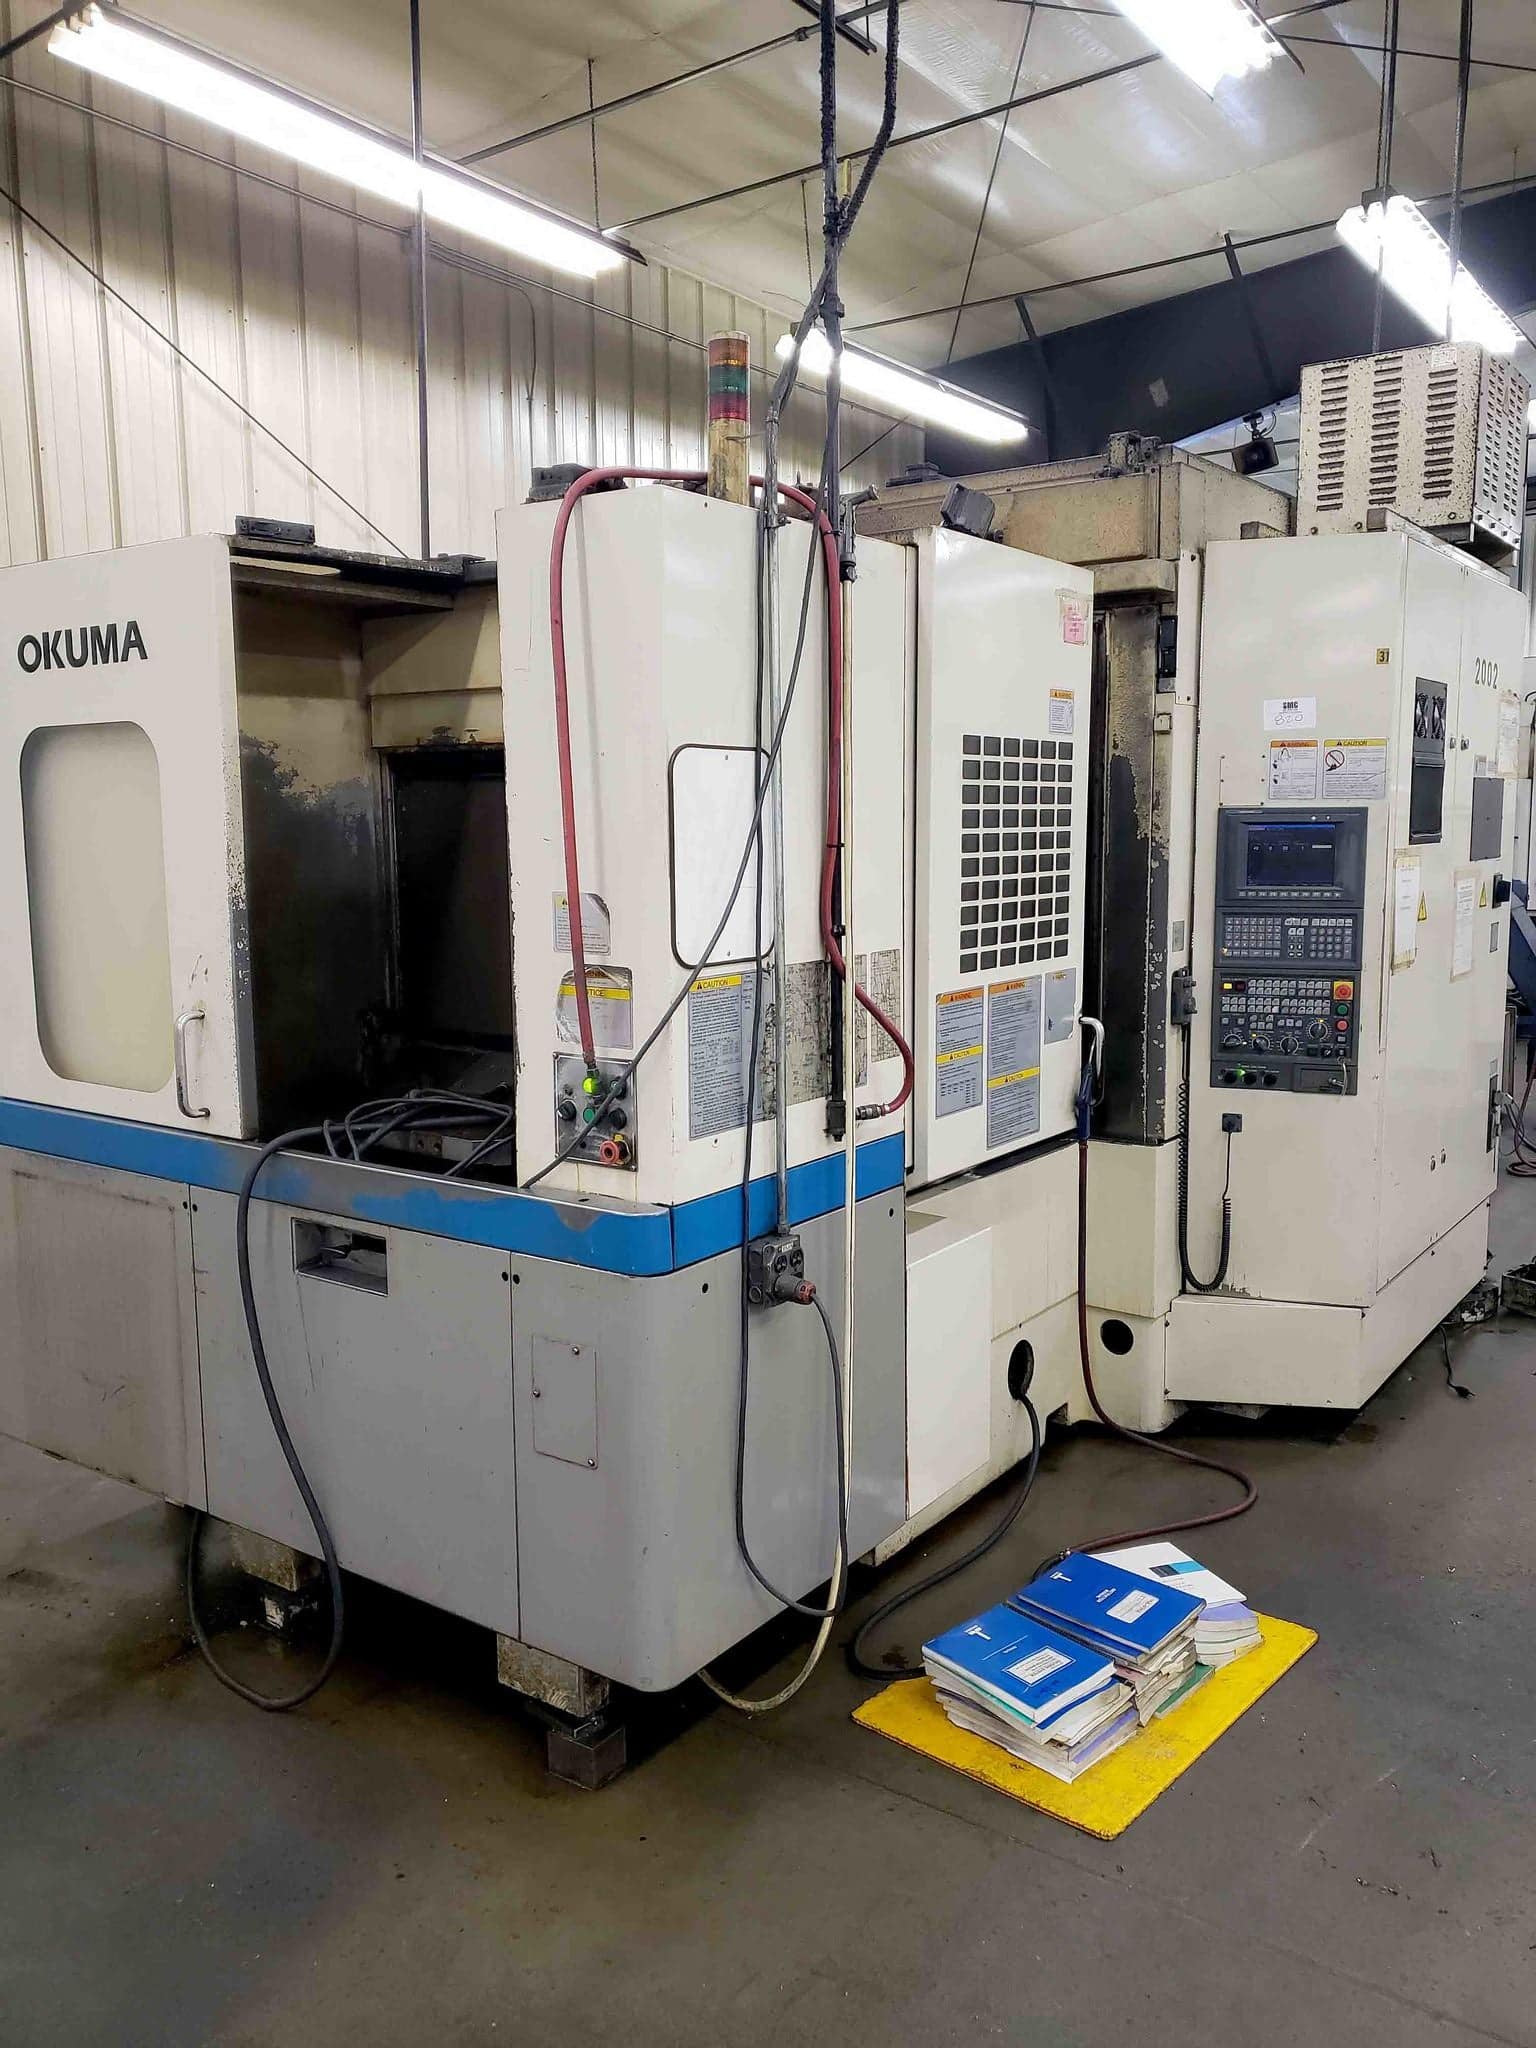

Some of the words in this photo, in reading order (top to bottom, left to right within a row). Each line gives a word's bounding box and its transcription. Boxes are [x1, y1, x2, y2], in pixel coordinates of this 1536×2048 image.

[17, 620, 148, 673] OKUMA
[1379, 650, 1390, 663] 31
[1474, 656, 1499, 690] 2002
[702, 979, 728, 989] CAUTION
